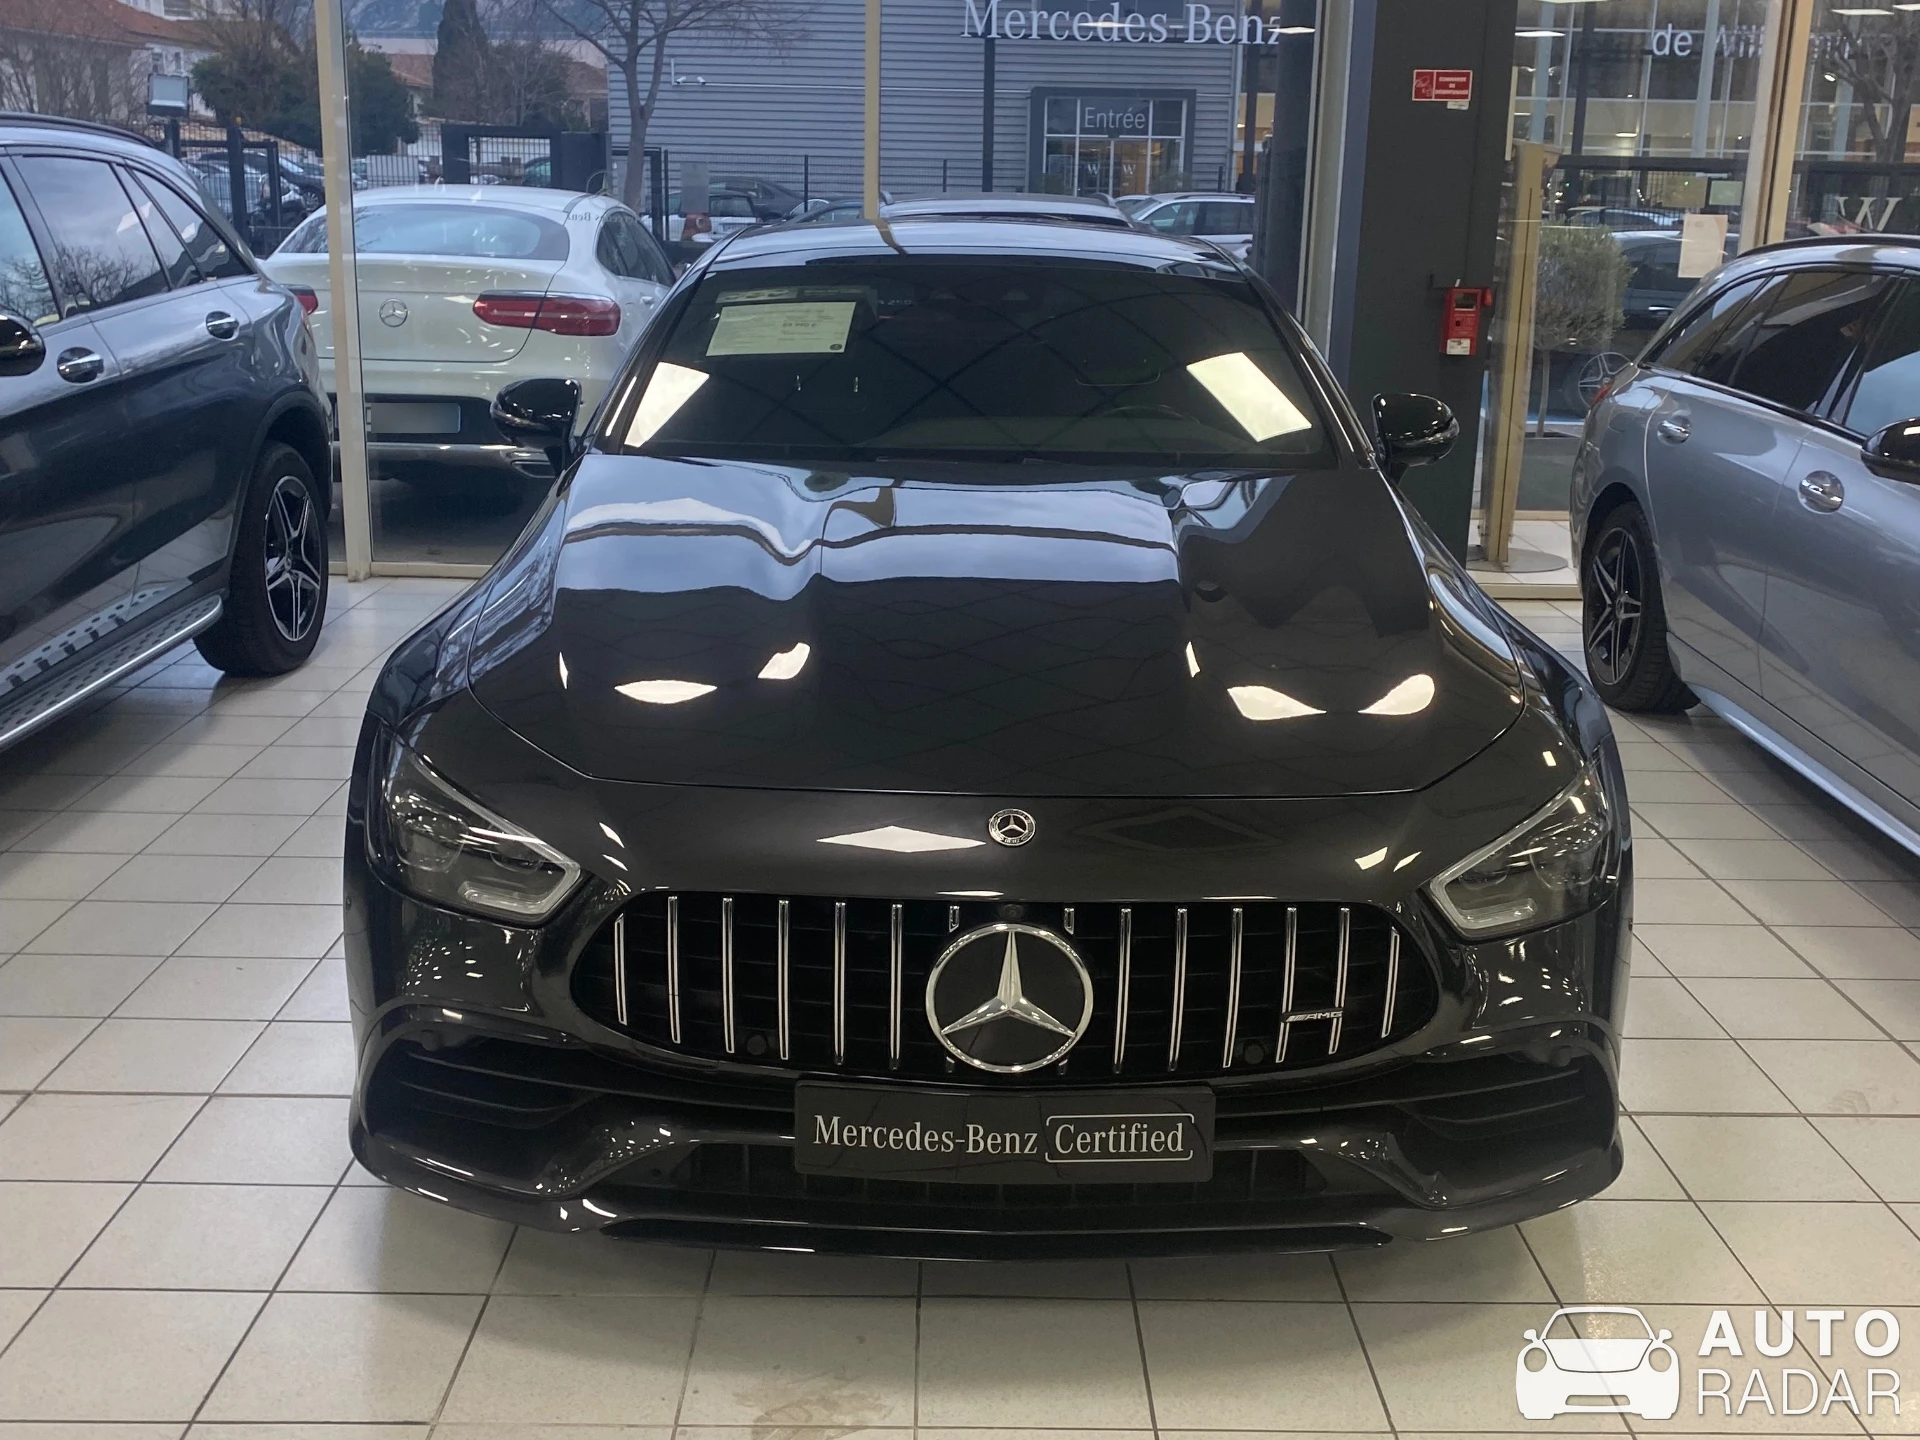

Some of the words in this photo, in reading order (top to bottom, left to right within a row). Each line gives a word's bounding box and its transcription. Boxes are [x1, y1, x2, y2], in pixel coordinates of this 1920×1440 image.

[960, 0, 1280, 45] Mercedes-Benz
[1653, 24, 1693, 56] de
[1084, 106, 1146, 129] Entrée
[813, 1114, 1038, 1155] Mercedes-Benz
[1054, 1122, 1184, 1155] Certified
